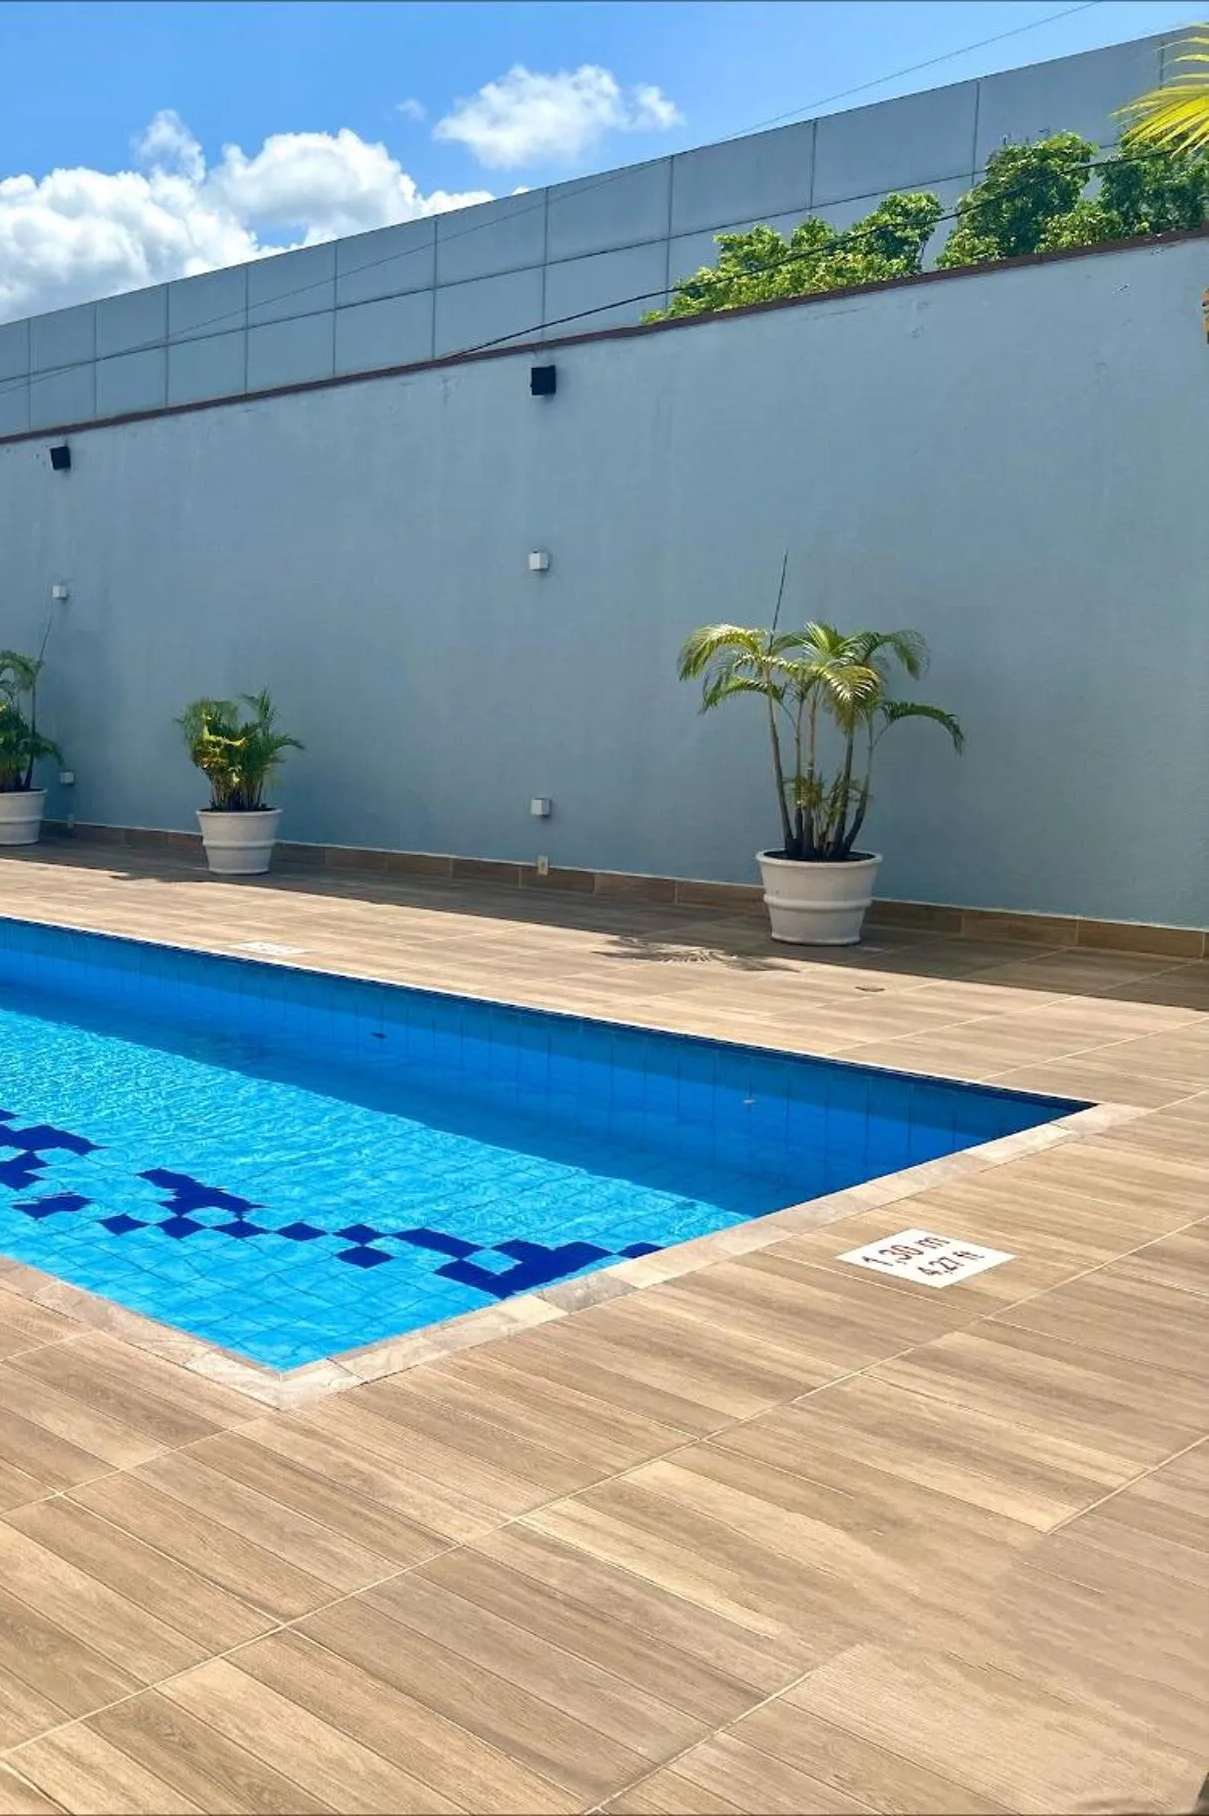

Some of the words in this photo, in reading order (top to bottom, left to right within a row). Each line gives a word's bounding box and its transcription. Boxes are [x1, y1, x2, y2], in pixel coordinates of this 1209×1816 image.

[861, 1244, 924, 1267] 1,30
[914, 1236, 950, 1250] m
[917, 1255, 965, 1276] 4,27
[952, 1250, 986, 1262] ft
